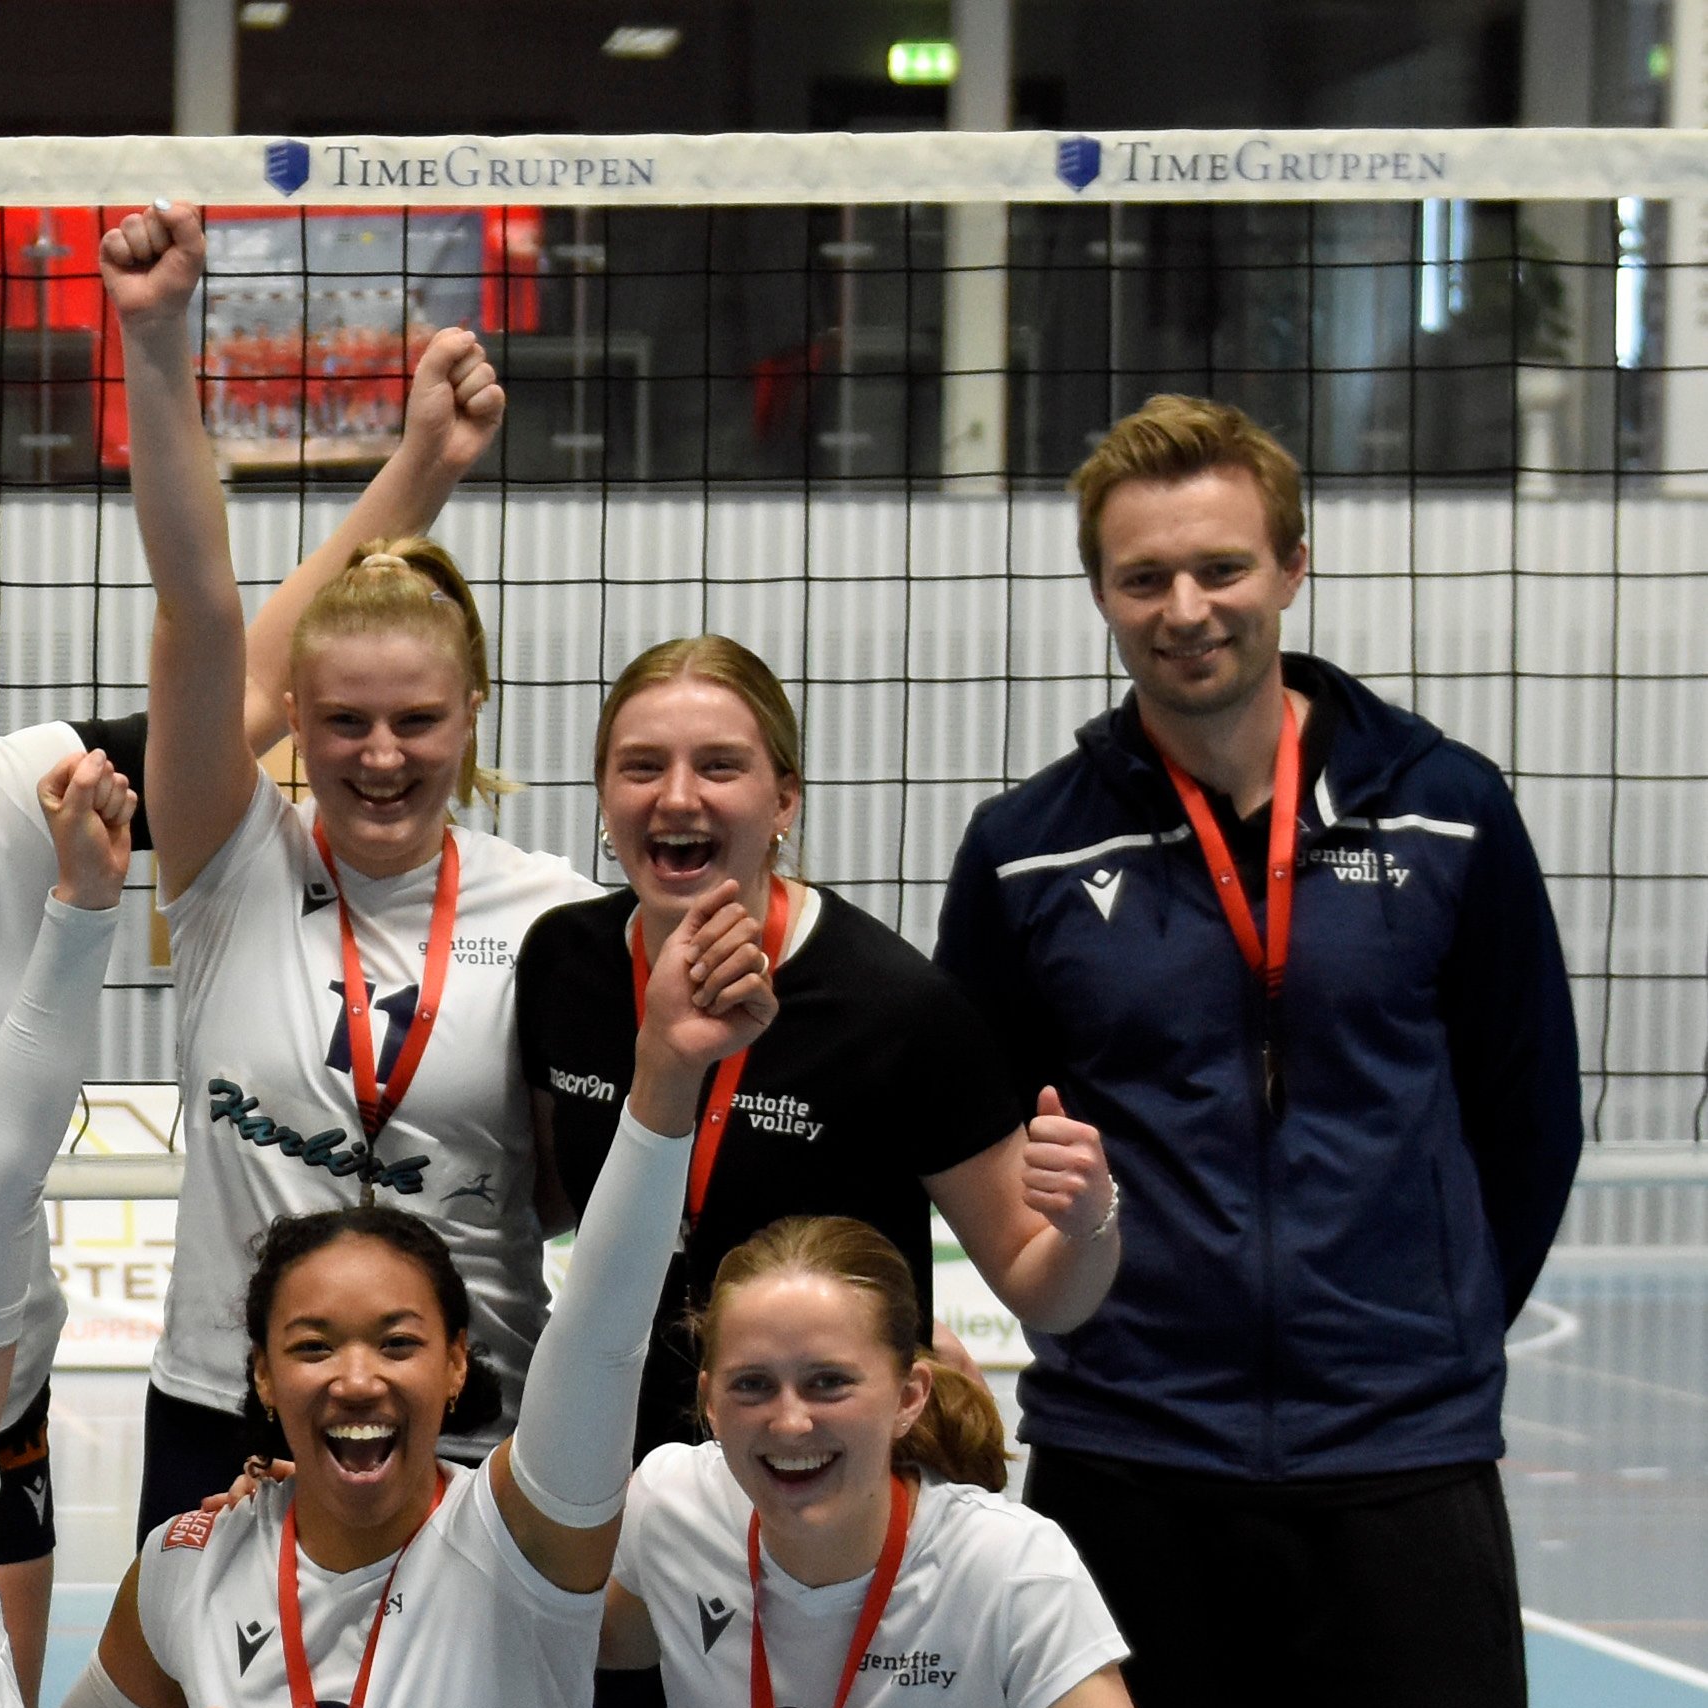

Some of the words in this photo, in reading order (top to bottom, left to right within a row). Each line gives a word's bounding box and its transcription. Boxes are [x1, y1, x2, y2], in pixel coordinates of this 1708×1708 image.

[418, 937, 508, 956] gntofte
[454, 952, 518, 970] volley
[749, 1111, 824, 1142] volley
[891, 1668, 958, 1690] olley
